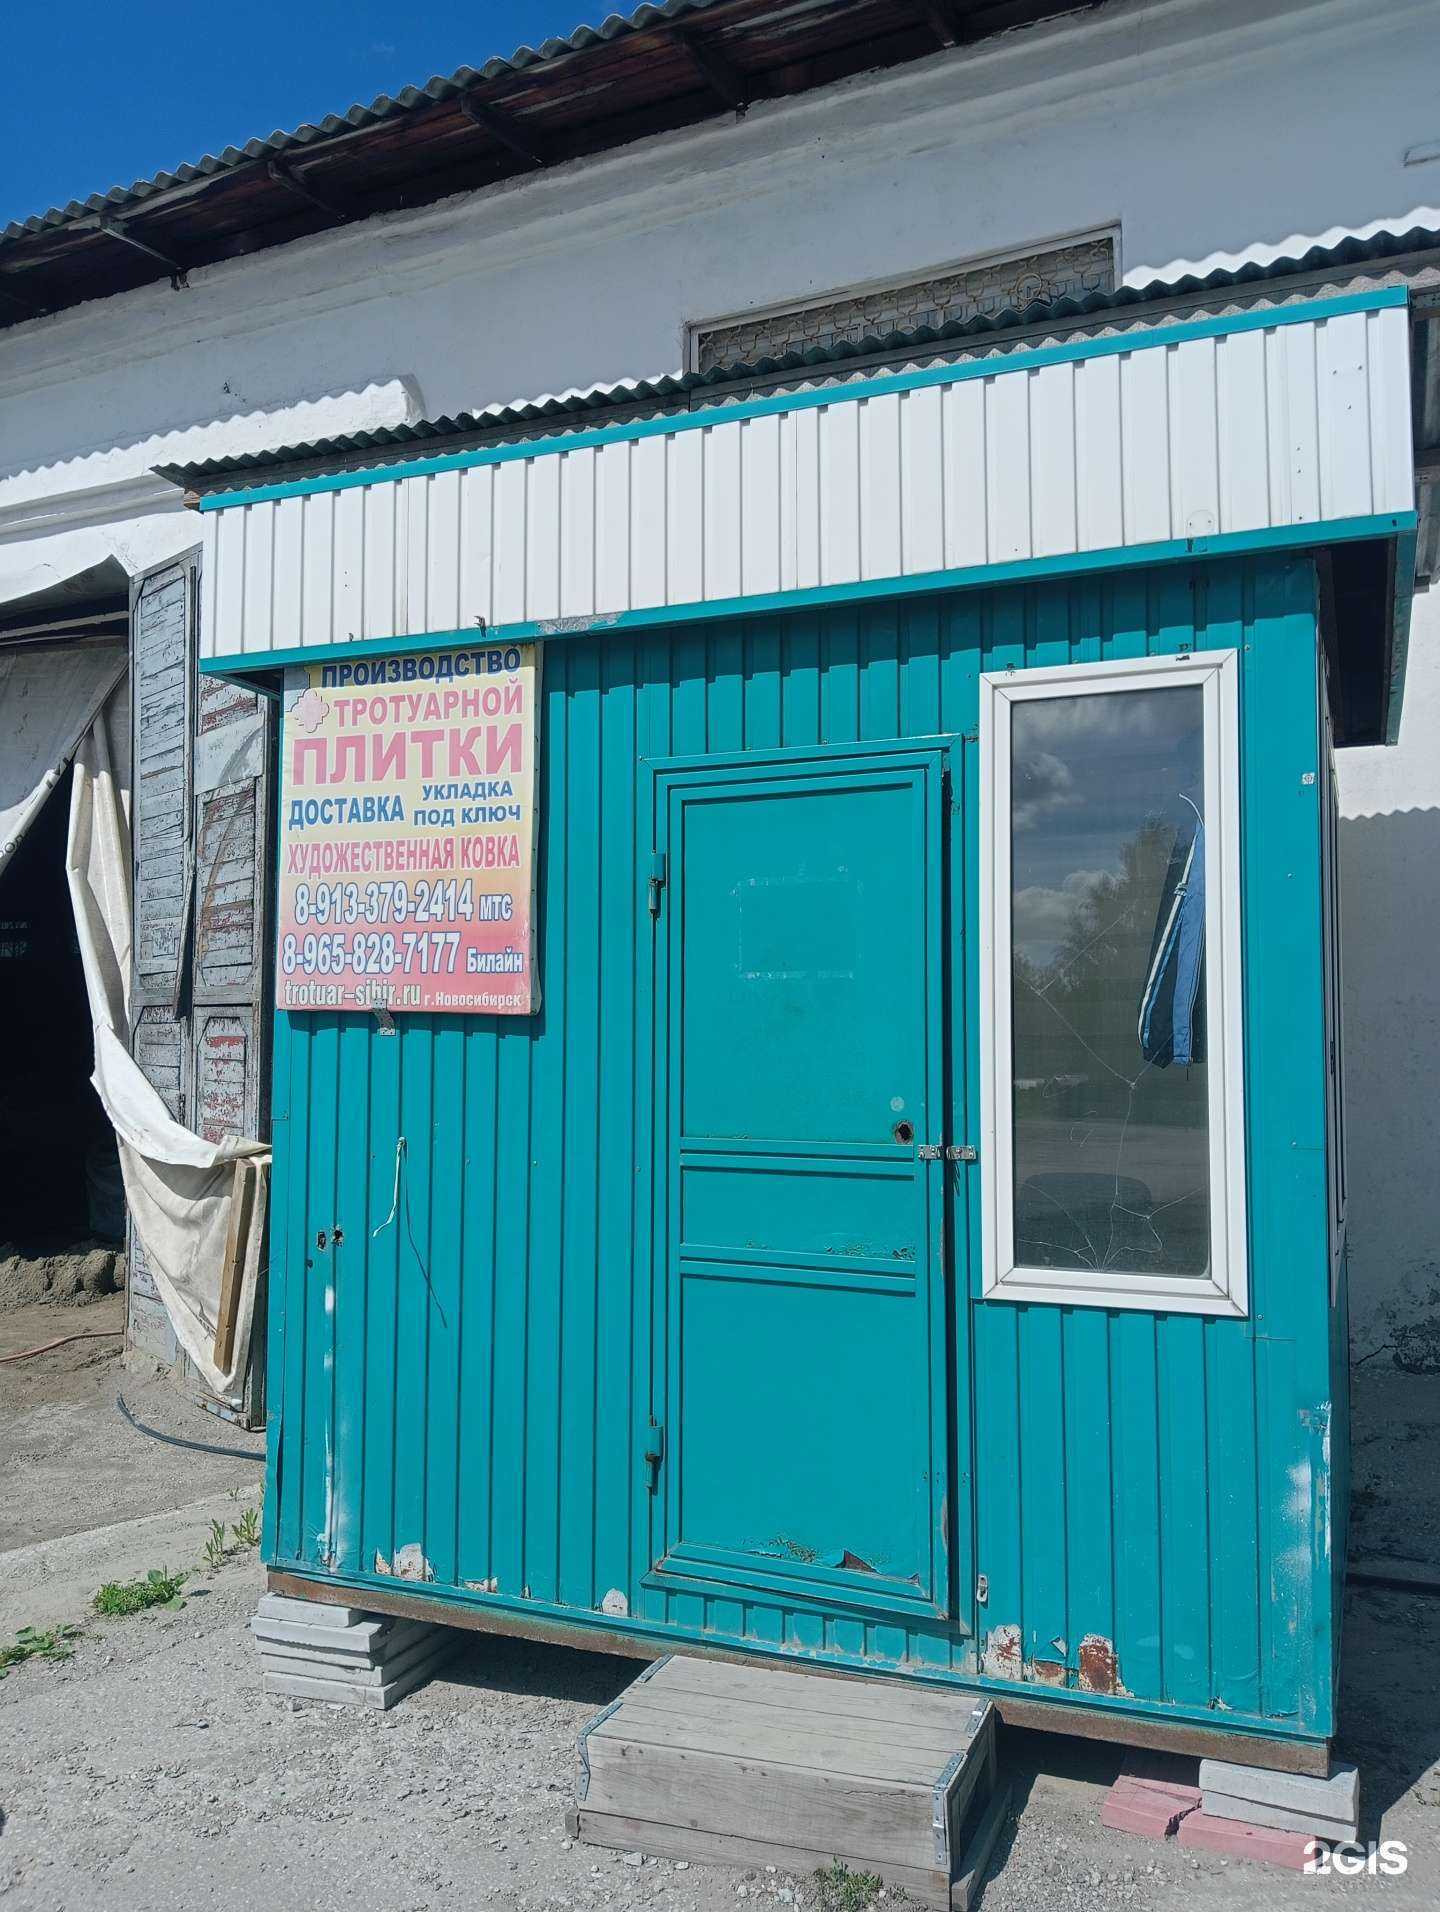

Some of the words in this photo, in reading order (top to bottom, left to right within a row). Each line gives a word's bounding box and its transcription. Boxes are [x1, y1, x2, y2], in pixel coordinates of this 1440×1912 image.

[321, 648, 521, 688] ПРОИЗВОДСТВО
[333, 676, 524, 727] ТРОТУАРНОЙ
[292, 723, 523, 786] ПЛИТКИ
[422, 781, 513, 801] УКЛАДКА
[288, 795, 405, 831] ДОСТАВКА
[413, 808, 455, 828] ПОД
[461, 805, 521, 824] КЛЮЧ
[287, 837, 454, 880] ХУДОЖЕСТВЕННАЯ
[461, 835, 520, 868] КОВКА
[294, 878, 474, 925] 8-913-379-2414
[479, 894, 513, 921] МТС
[282, 931, 461, 975] 8-965-828-7177
[466, 946, 524, 973] Билайн
[285, 978, 421, 1007] trotuar-sibir.ru
